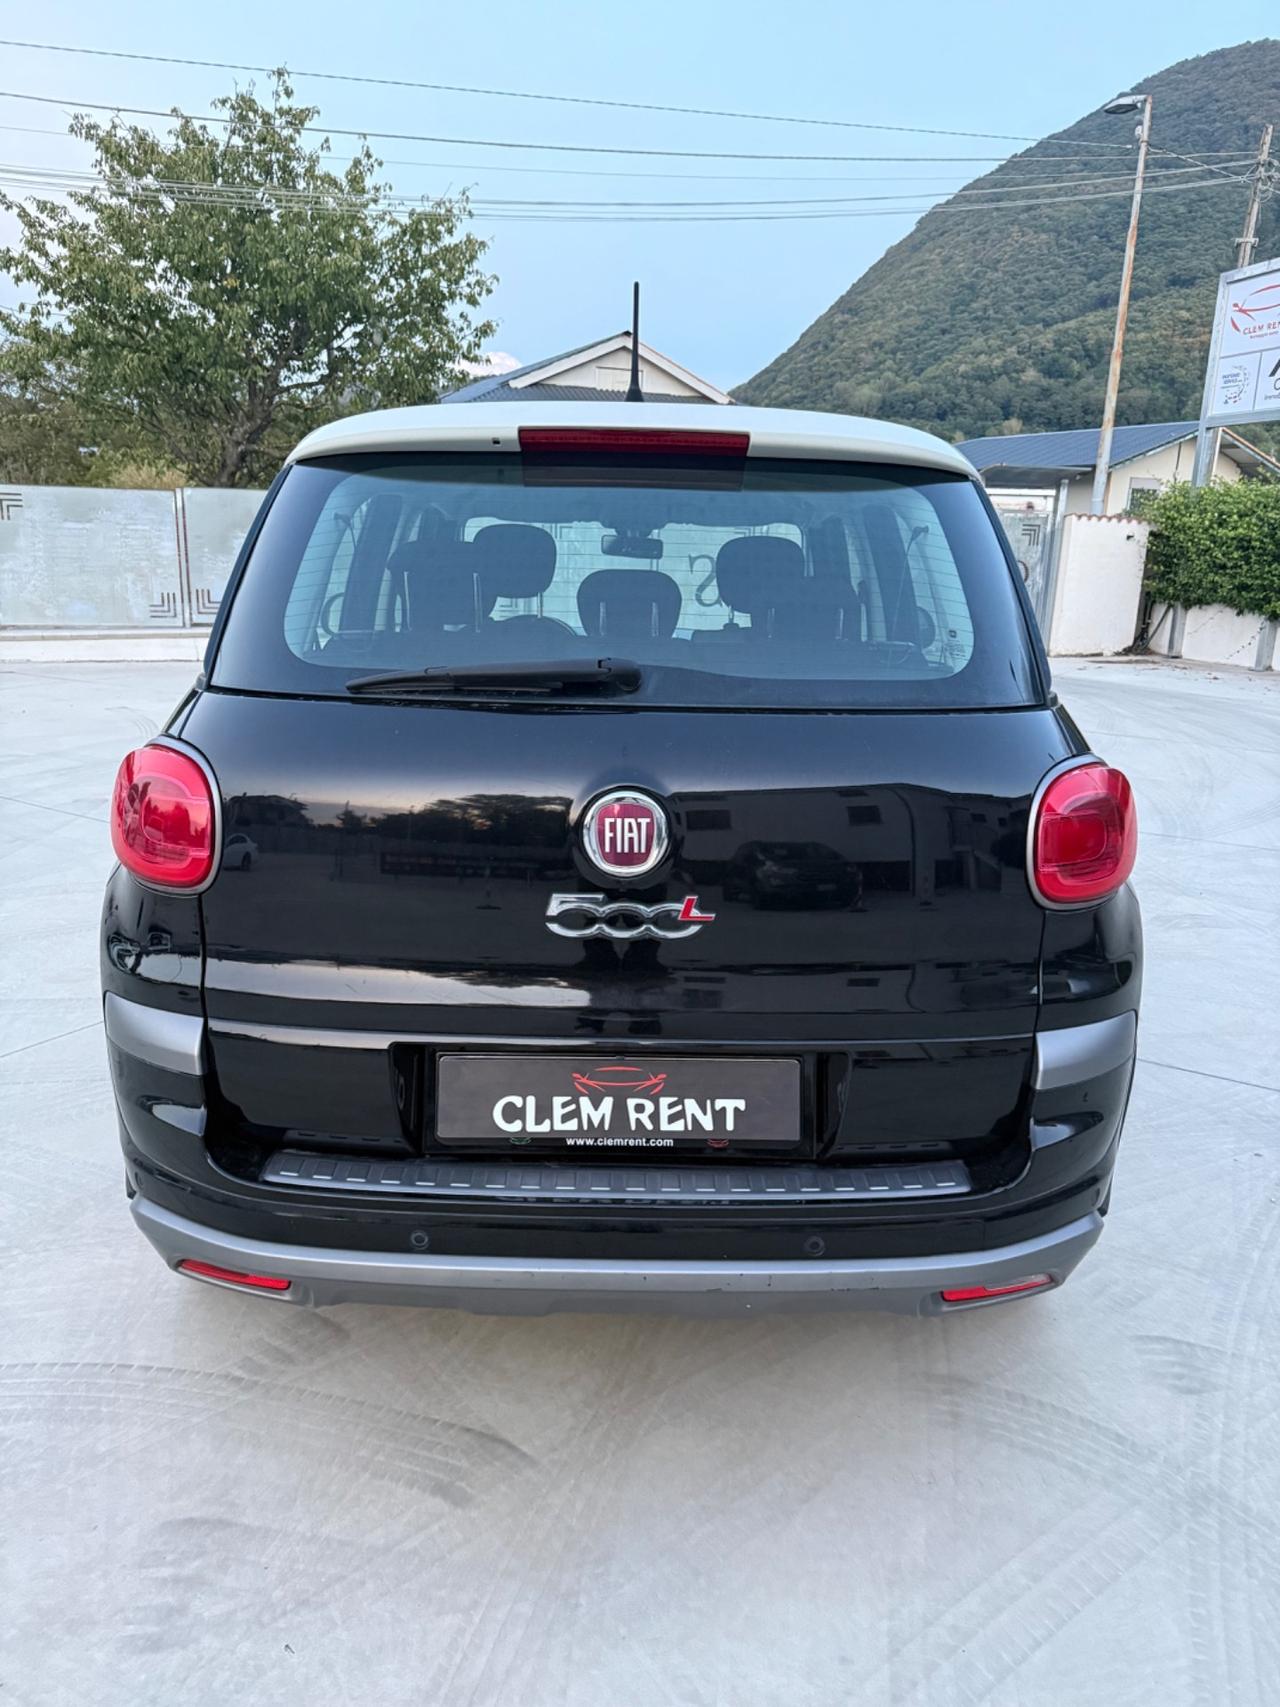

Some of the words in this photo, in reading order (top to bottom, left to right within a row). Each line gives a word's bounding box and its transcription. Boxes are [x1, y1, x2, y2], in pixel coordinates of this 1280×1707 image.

[604, 817, 651, 854] FIAT
[492, 1095, 614, 1133] CLEM
[626, 1096, 746, 1132] RENT
[566, 1136, 674, 1148] www.clemrent.com
